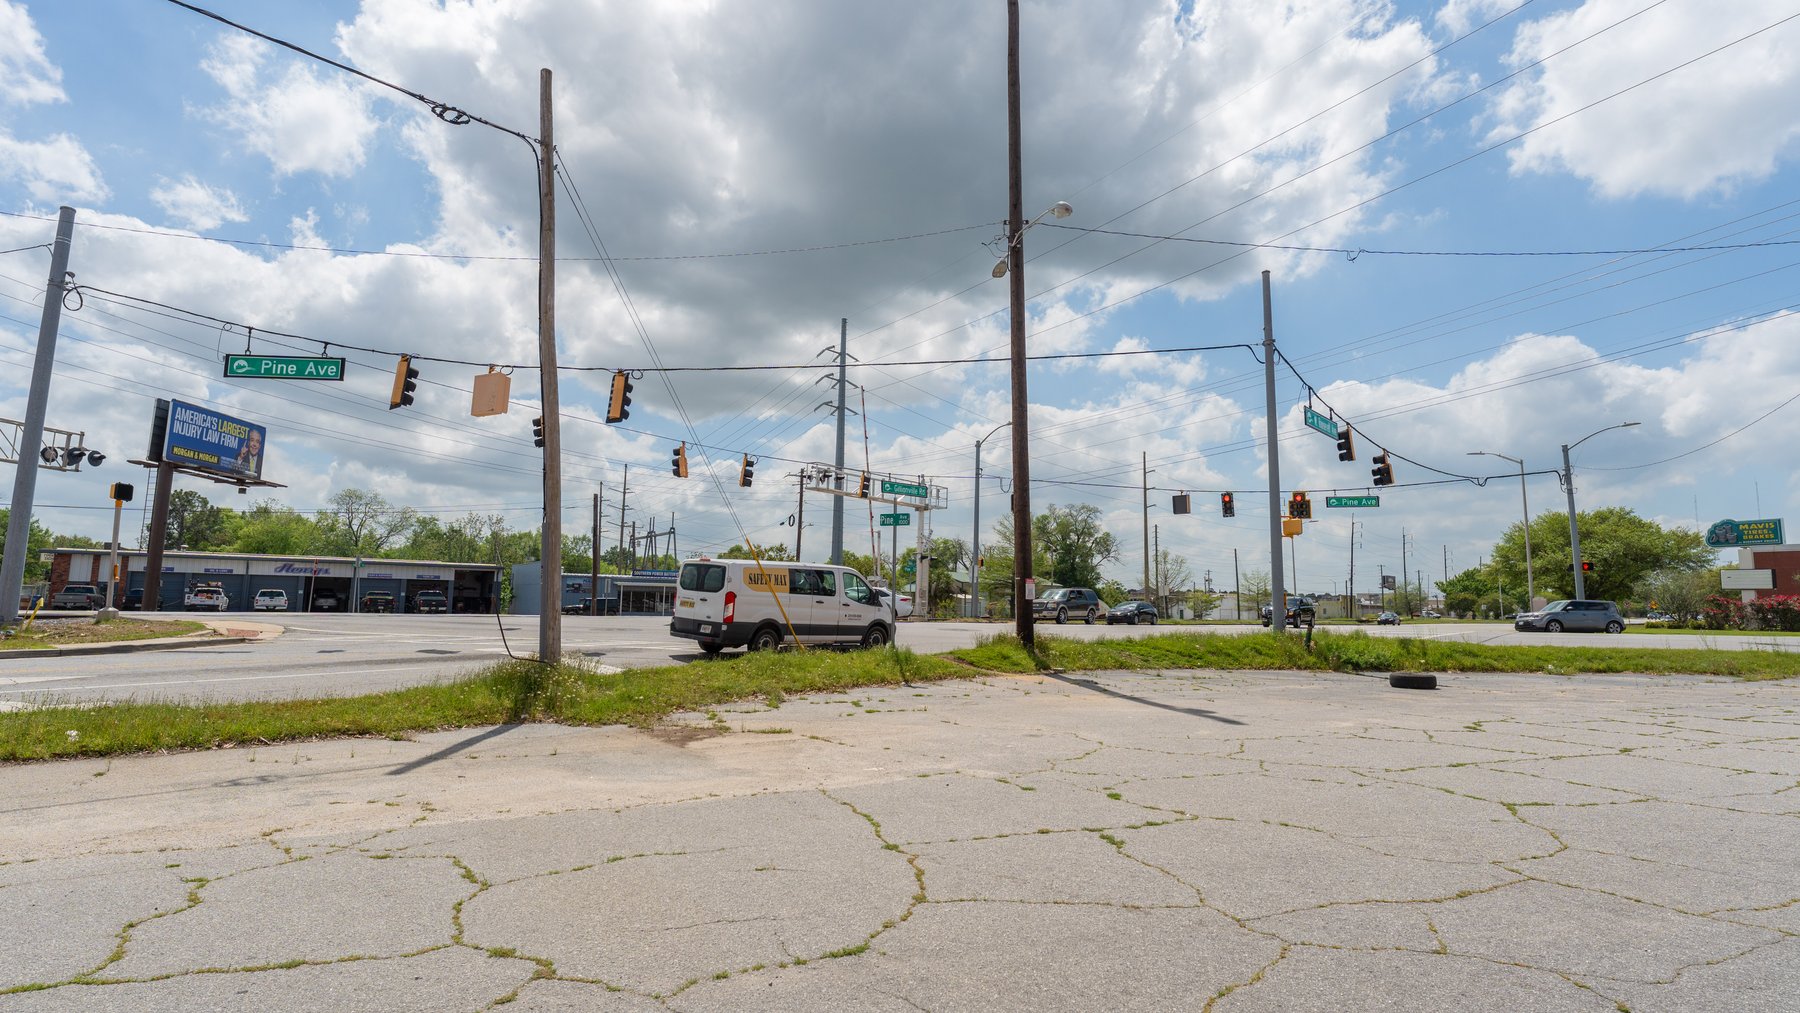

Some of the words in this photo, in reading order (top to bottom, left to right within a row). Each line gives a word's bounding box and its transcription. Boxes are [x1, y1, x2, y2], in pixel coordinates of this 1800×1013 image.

[261, 360, 297, 374] Pine
[304, 361, 337, 376] Ave
[174, 407, 218, 430] AMERICA'S
[218, 419, 250, 439] LARGEST
[173, 420, 203, 439] INJURY
[203, 428, 220, 444] LAW
[220, 433, 239, 449] FIRM
[172, 446, 195, 460] MORGAN
[194, 452, 199, 460] &
[198, 452, 219, 464] MORGAN
[919, 488, 926, 496] Rd
[1342, 498, 1359, 506] Pine
[1361, 498, 1376, 506] Ave
[880, 516, 894, 524] Pine
[748, 572, 773, 585] SAFETY
[773, 573, 788, 586] MAX
